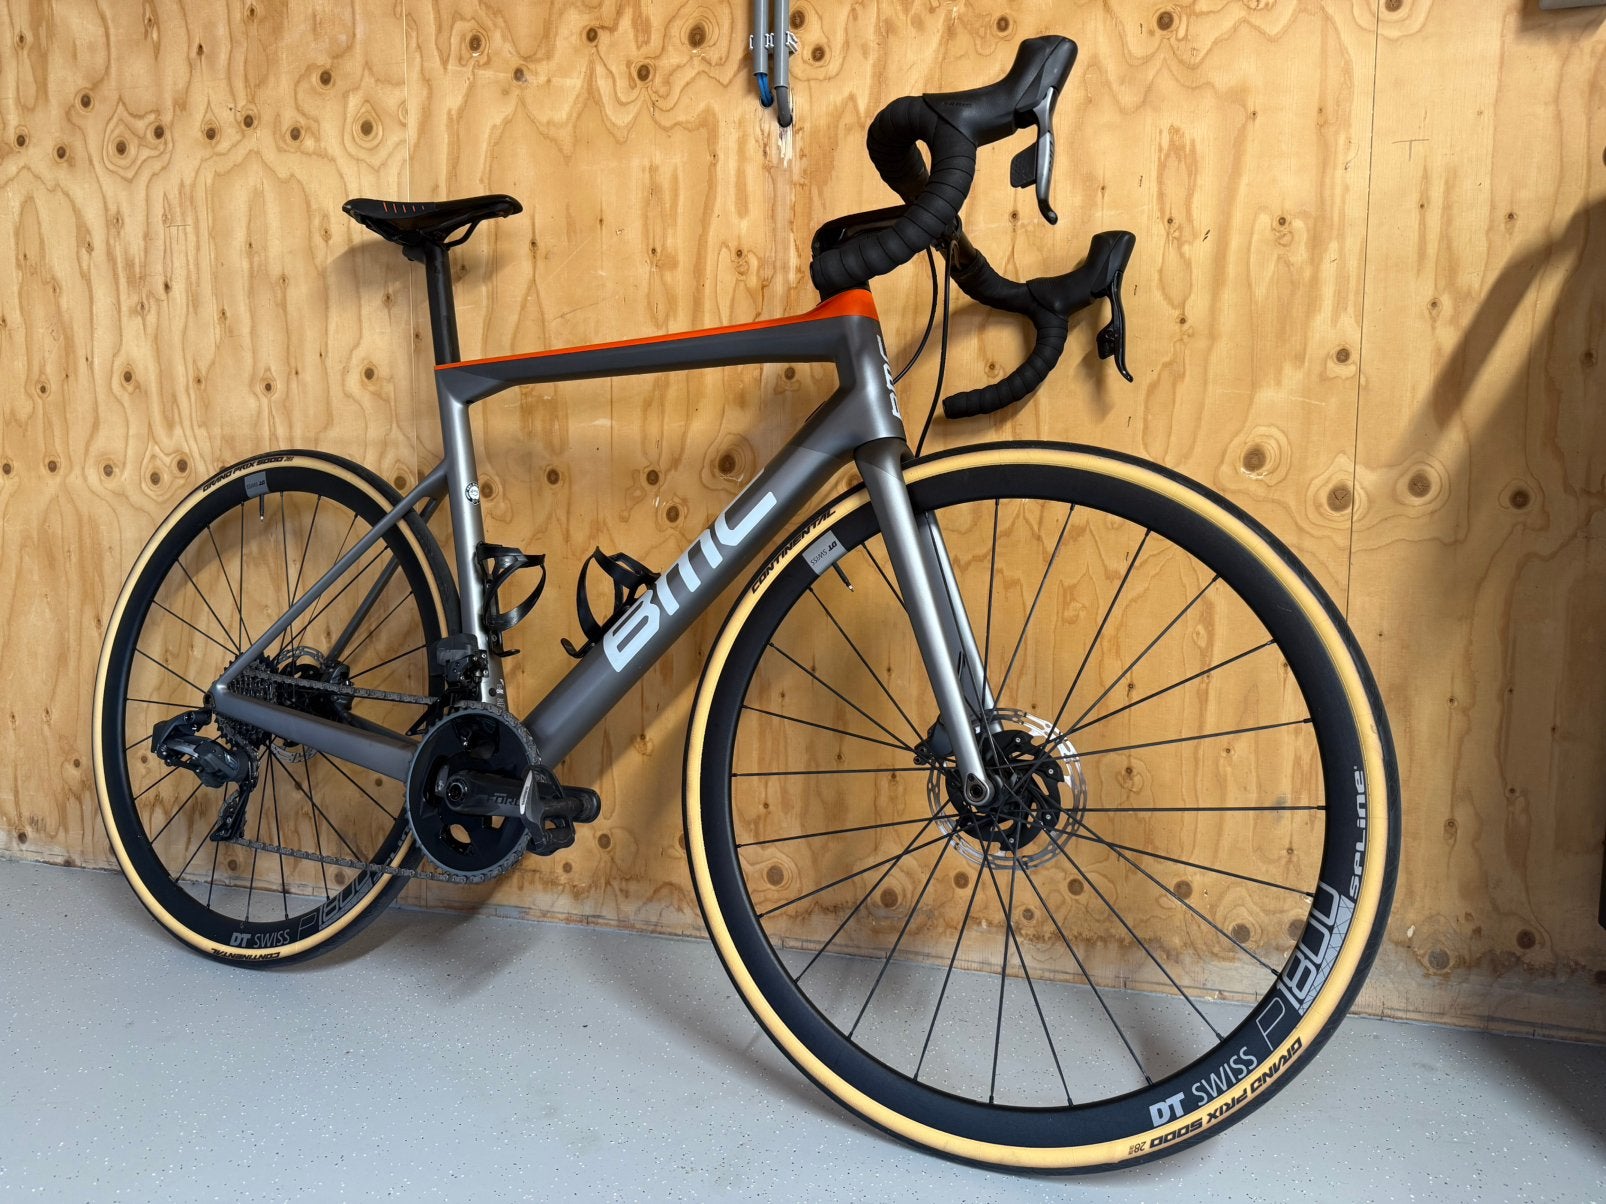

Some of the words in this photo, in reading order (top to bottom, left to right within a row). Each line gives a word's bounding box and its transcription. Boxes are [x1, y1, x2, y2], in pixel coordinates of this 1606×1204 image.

[202, 470, 232, 492] GRAND
[232, 461, 256, 475] PRIX
[256, 456, 285, 466] 5000
[751, 508, 836, 594] CONTINENTAL
[810, 548, 828, 567] SWISS
[828, 540, 838, 552] DT
[602, 468, 778, 673] BMC
[211, 948, 281, 960] CONTINENTAL
[229, 932, 251, 947] DT
[254, 928, 290, 948] SWISS
[1250, 1035, 1303, 1095] GRAND
[1149, 1091, 1186, 1128] DT
[1191, 1046, 1258, 1106] SWISS
[1206, 1087, 1248, 1125] PRIX
[1149, 1116, 1203, 1149] 5000
